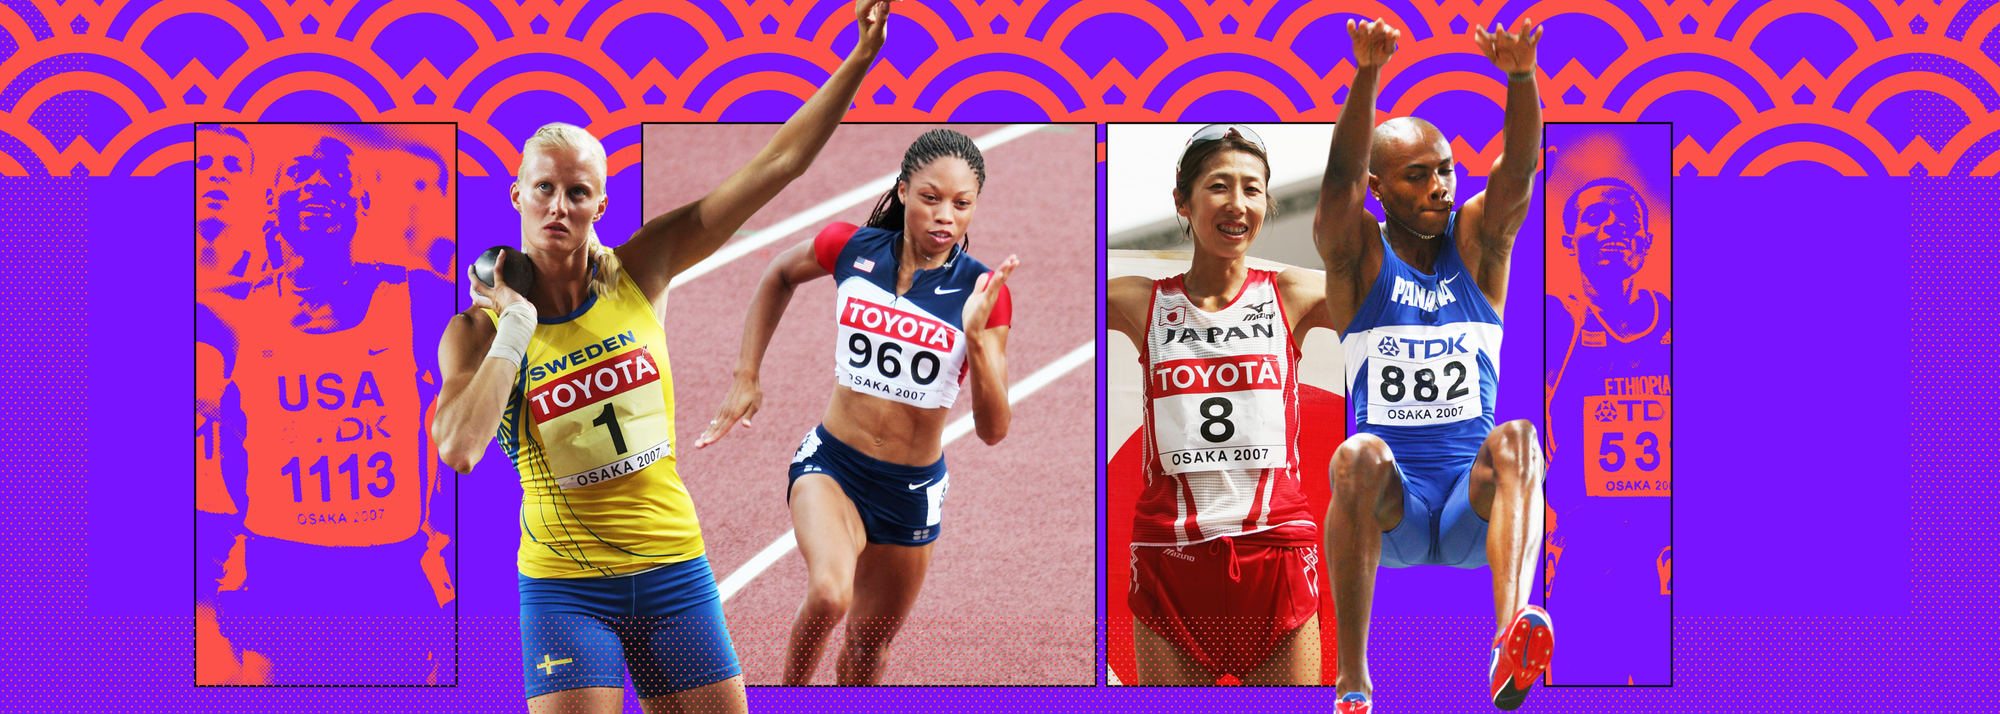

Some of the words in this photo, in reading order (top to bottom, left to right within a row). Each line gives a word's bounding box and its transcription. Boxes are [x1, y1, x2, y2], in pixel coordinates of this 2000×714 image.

[849, 302, 949, 349] TOYOTA
[1162, 323, 1274, 345] JAPAN
[1400, 332, 1469, 359] TDK
[529, 330, 637, 381] SWEDEN
[848, 333, 940, 385] 960
[278, 371, 385, 412] USA
[531, 355, 657, 415] TOYOTA
[895, 388, 926, 401] 2007
[1156, 361, 1279, 391] TOYOTA
[1380, 361, 1469, 402] 882
[317, 415, 391, 442] DK
[592, 402, 628, 455] 1
[1200, 397, 1235, 443] 8
[1387, 409, 1432, 420] OSAKA
[1436, 406, 1464, 418] 2007
[577, 461, 634, 486] OSAKA
[637, 447, 662, 469] 2007
[1172, 450, 1228, 466] OSAKA
[1234, 449, 1269, 461] 2007
[1598, 431, 1671, 473] 53
[281, 451, 395, 503] 1113
[1605, 480, 1651, 491] OSAKA
[297, 513, 347, 525] OSAKA
[354, 509, 385, 523] 2007
